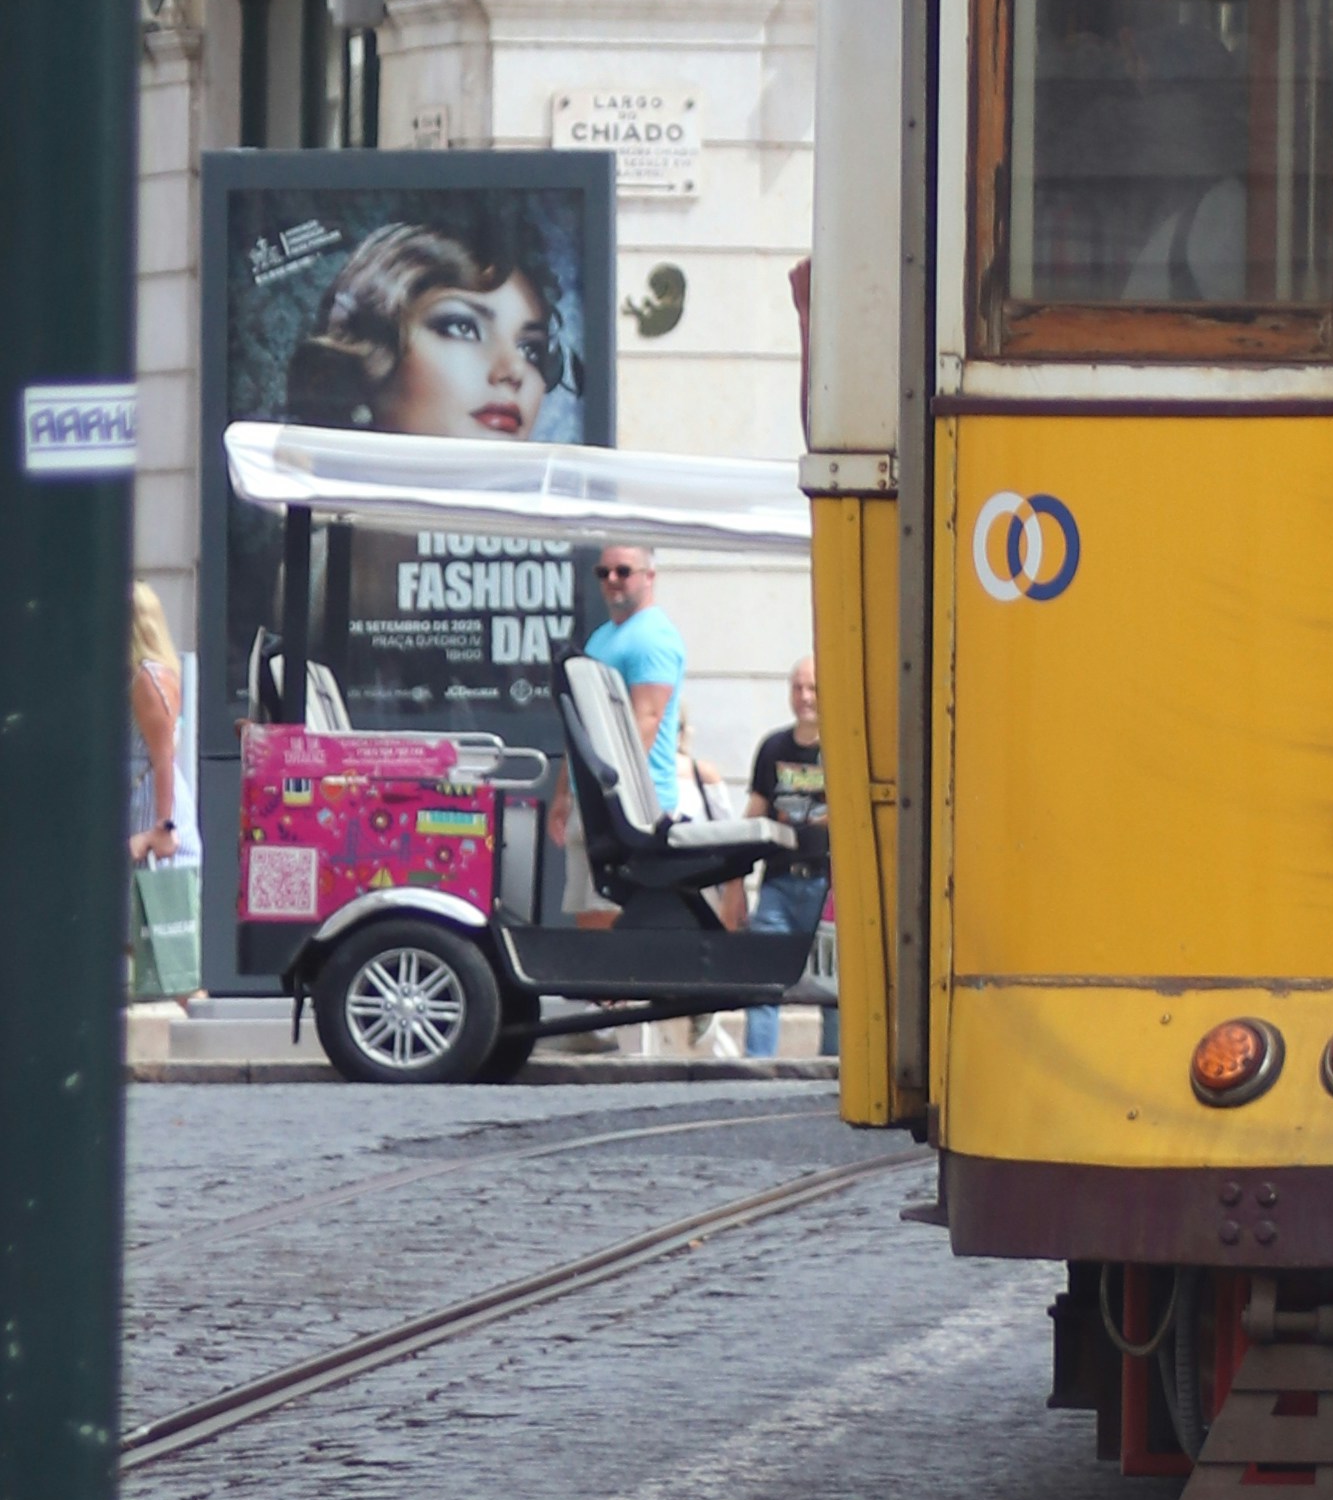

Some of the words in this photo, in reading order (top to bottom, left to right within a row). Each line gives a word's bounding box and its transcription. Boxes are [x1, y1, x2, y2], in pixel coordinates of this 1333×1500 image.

[593, 95, 663, 109] LARGO
[571, 121, 684, 142] CHIADO
[398, 560, 575, 612] FASHION
[366, 619, 430, 632] SETEMBRO
[491, 614, 574, 665] DAY
